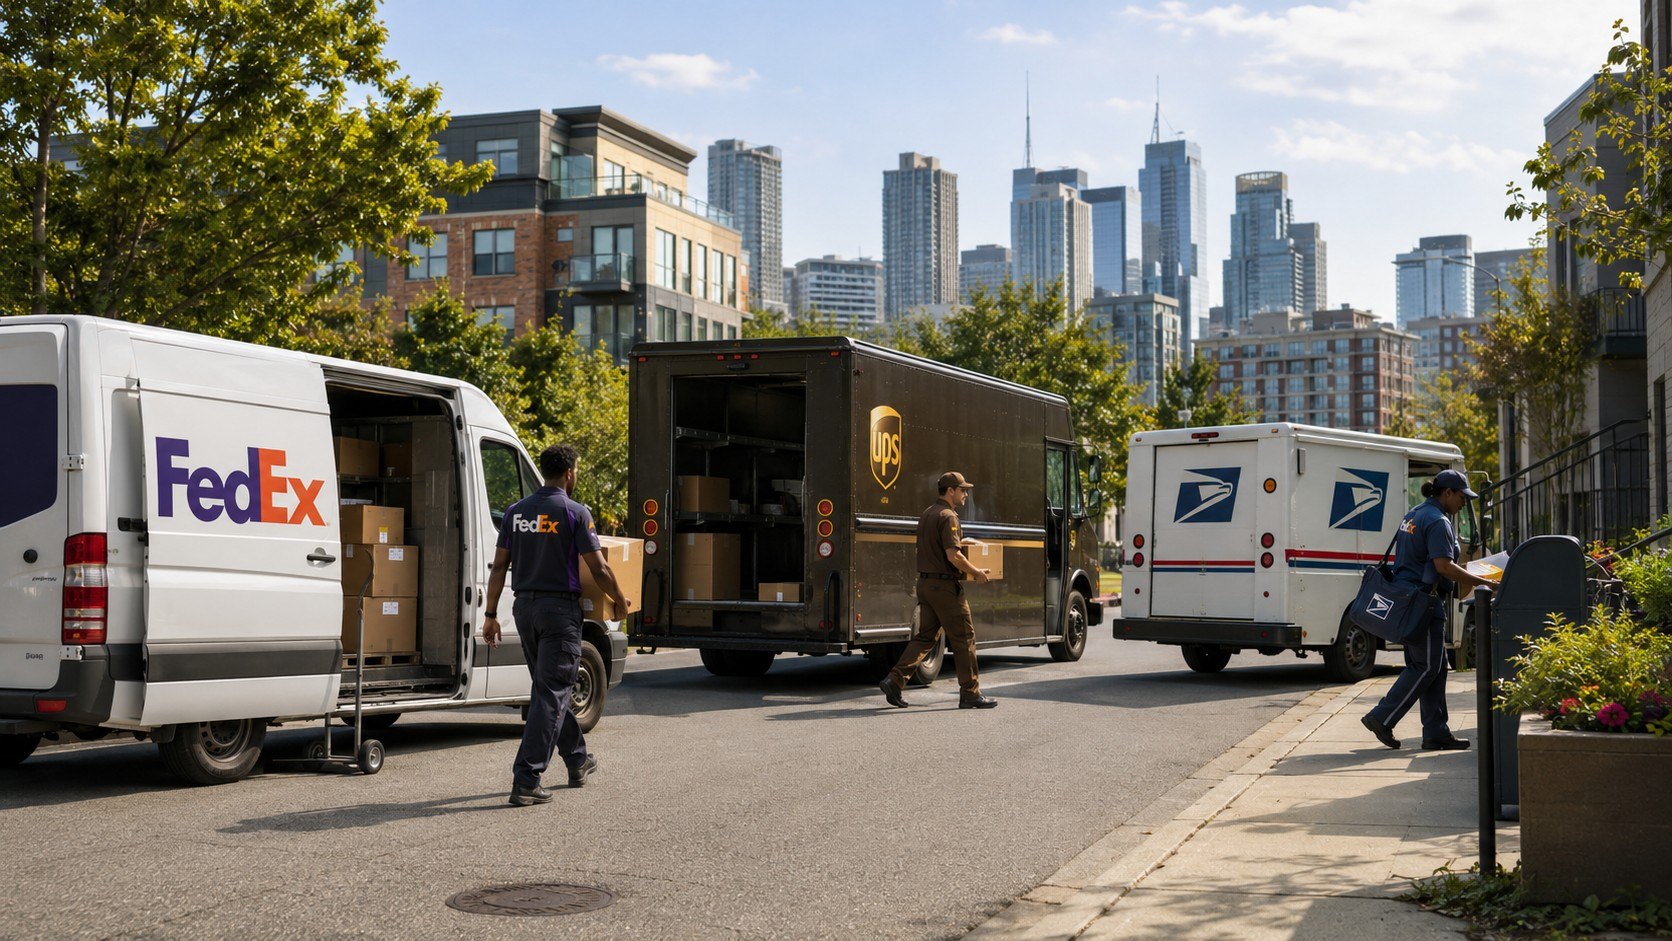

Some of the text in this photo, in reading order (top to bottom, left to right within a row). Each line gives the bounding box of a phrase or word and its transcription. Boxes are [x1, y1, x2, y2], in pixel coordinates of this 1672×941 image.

[872, 431, 900, 476] ups
[155, 436, 326, 526] FedEx
[512, 513, 560, 534] FedEx
